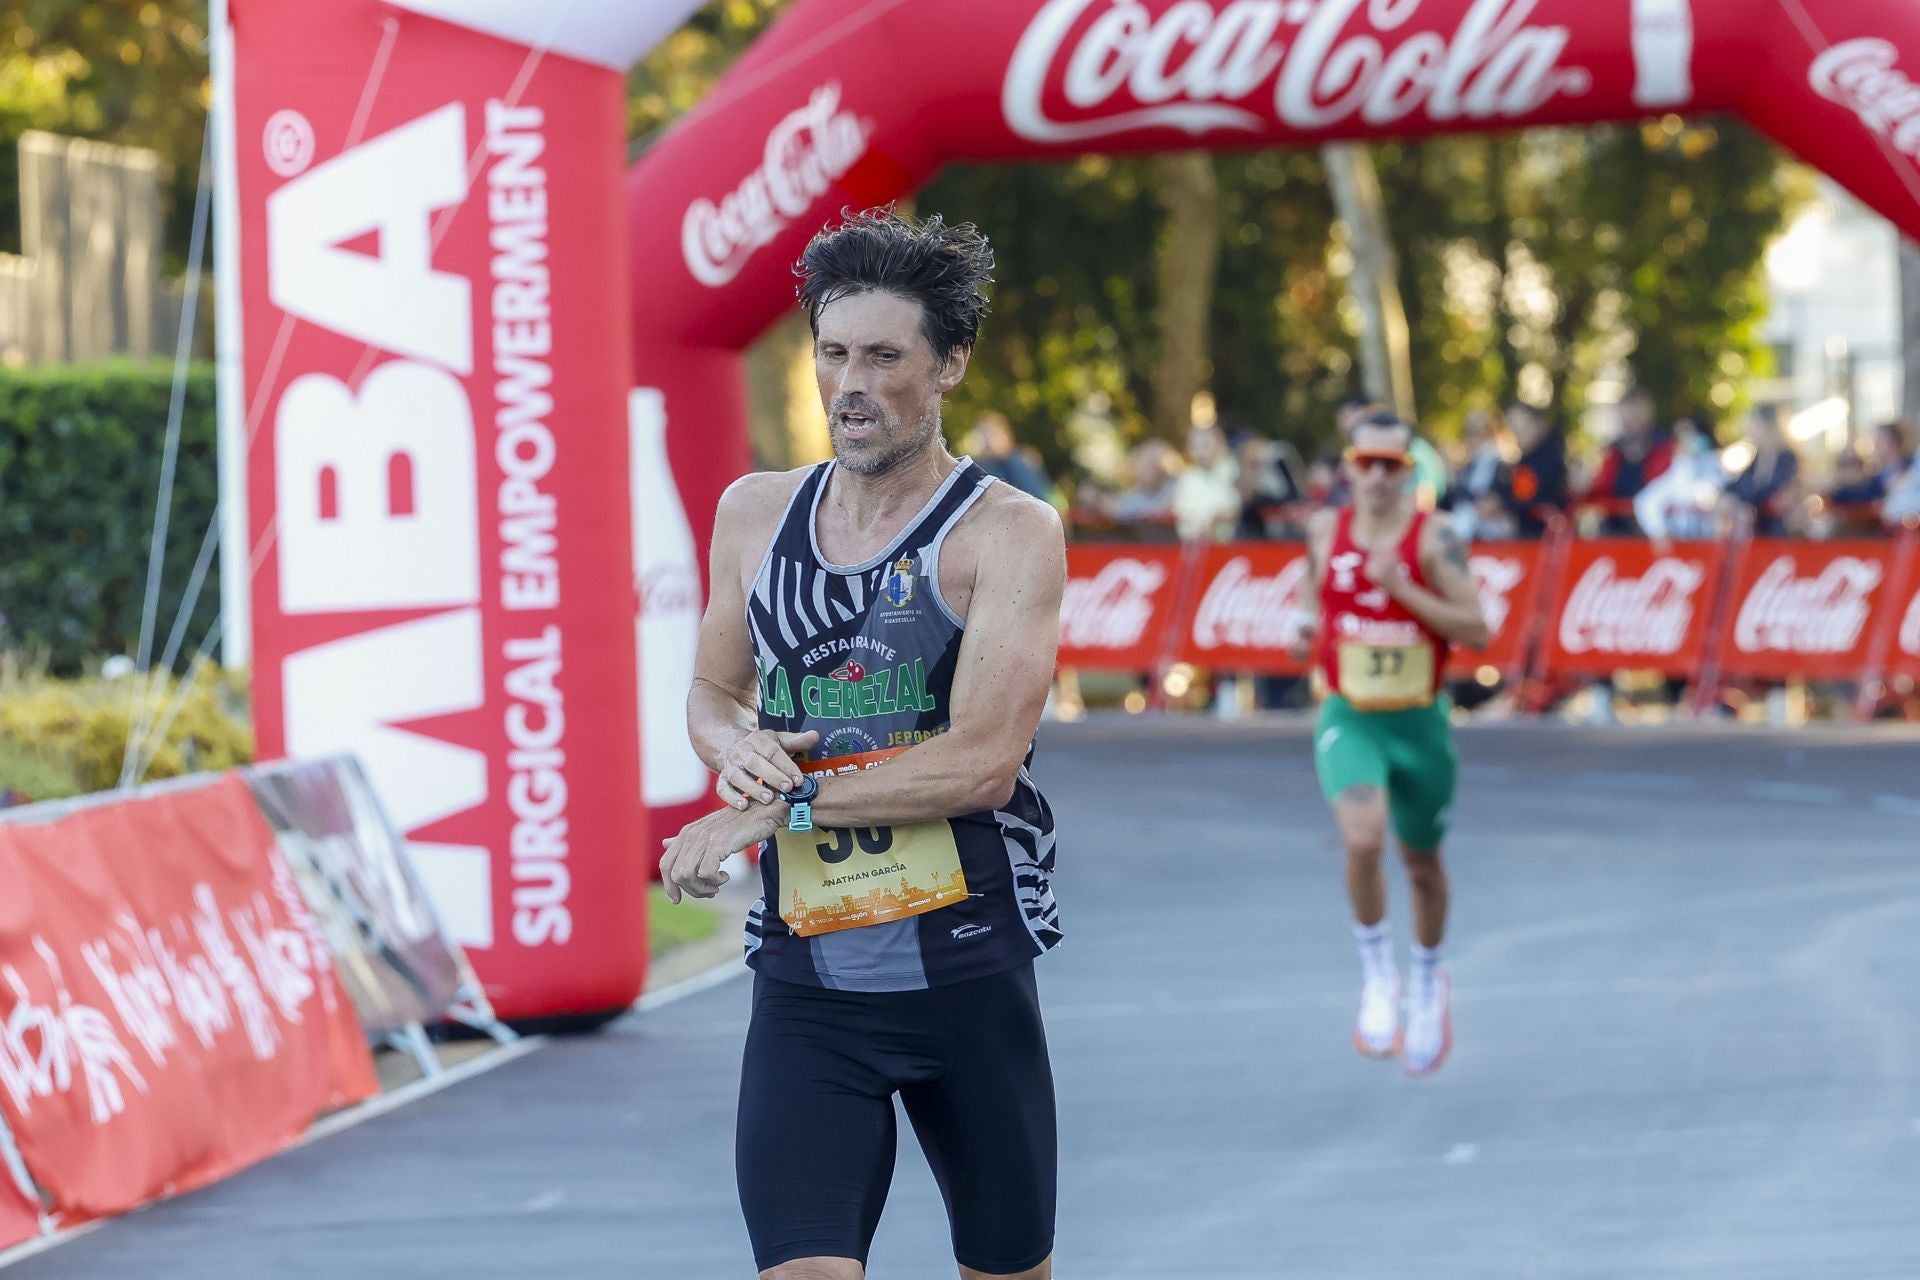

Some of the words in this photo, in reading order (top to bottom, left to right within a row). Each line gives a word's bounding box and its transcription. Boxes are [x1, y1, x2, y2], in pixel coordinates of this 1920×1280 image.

[484, 98, 561, 610] EMPOWERMENT
[758, 655, 796, 718] LA
[801, 657, 936, 719] CEREZAL
[502, 624, 572, 945] SURGICAL
[821, 871, 870, 887] JNATHAN
[870, 863, 907, 877] GARCÍA
